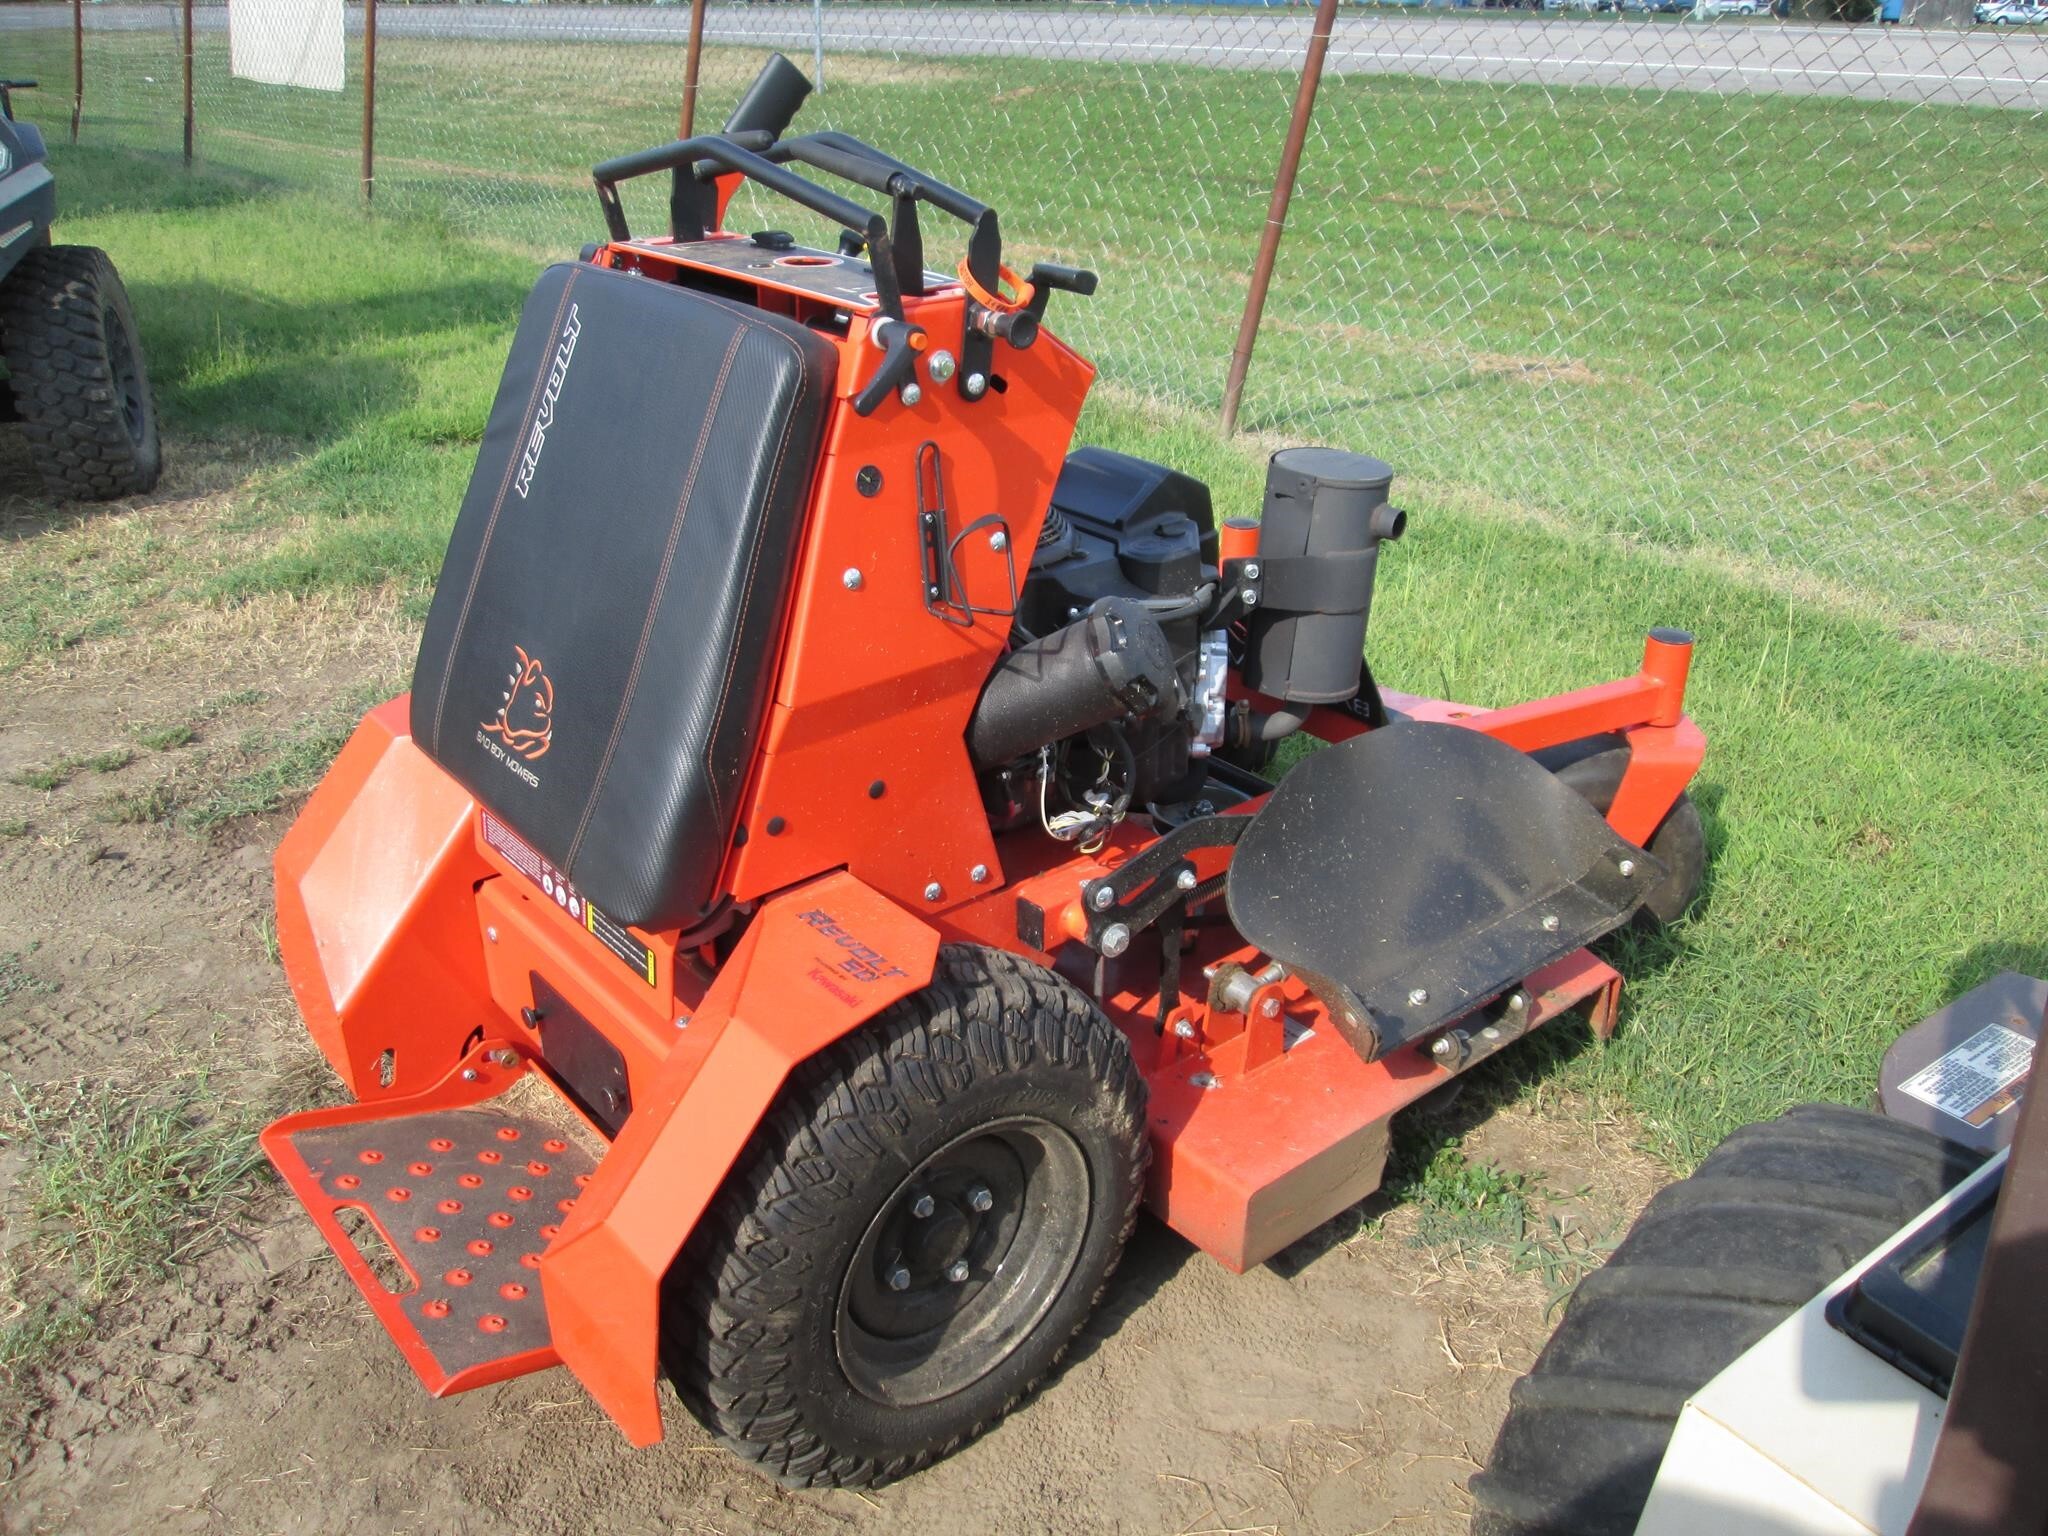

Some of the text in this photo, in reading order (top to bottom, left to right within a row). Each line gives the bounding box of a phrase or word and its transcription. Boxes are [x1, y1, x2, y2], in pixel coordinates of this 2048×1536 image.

[515, 303, 581, 499] REVOLT
[476, 730, 540, 788] BAD BOY MOWERS
[808, 968, 863, 1008] Kawasaki
